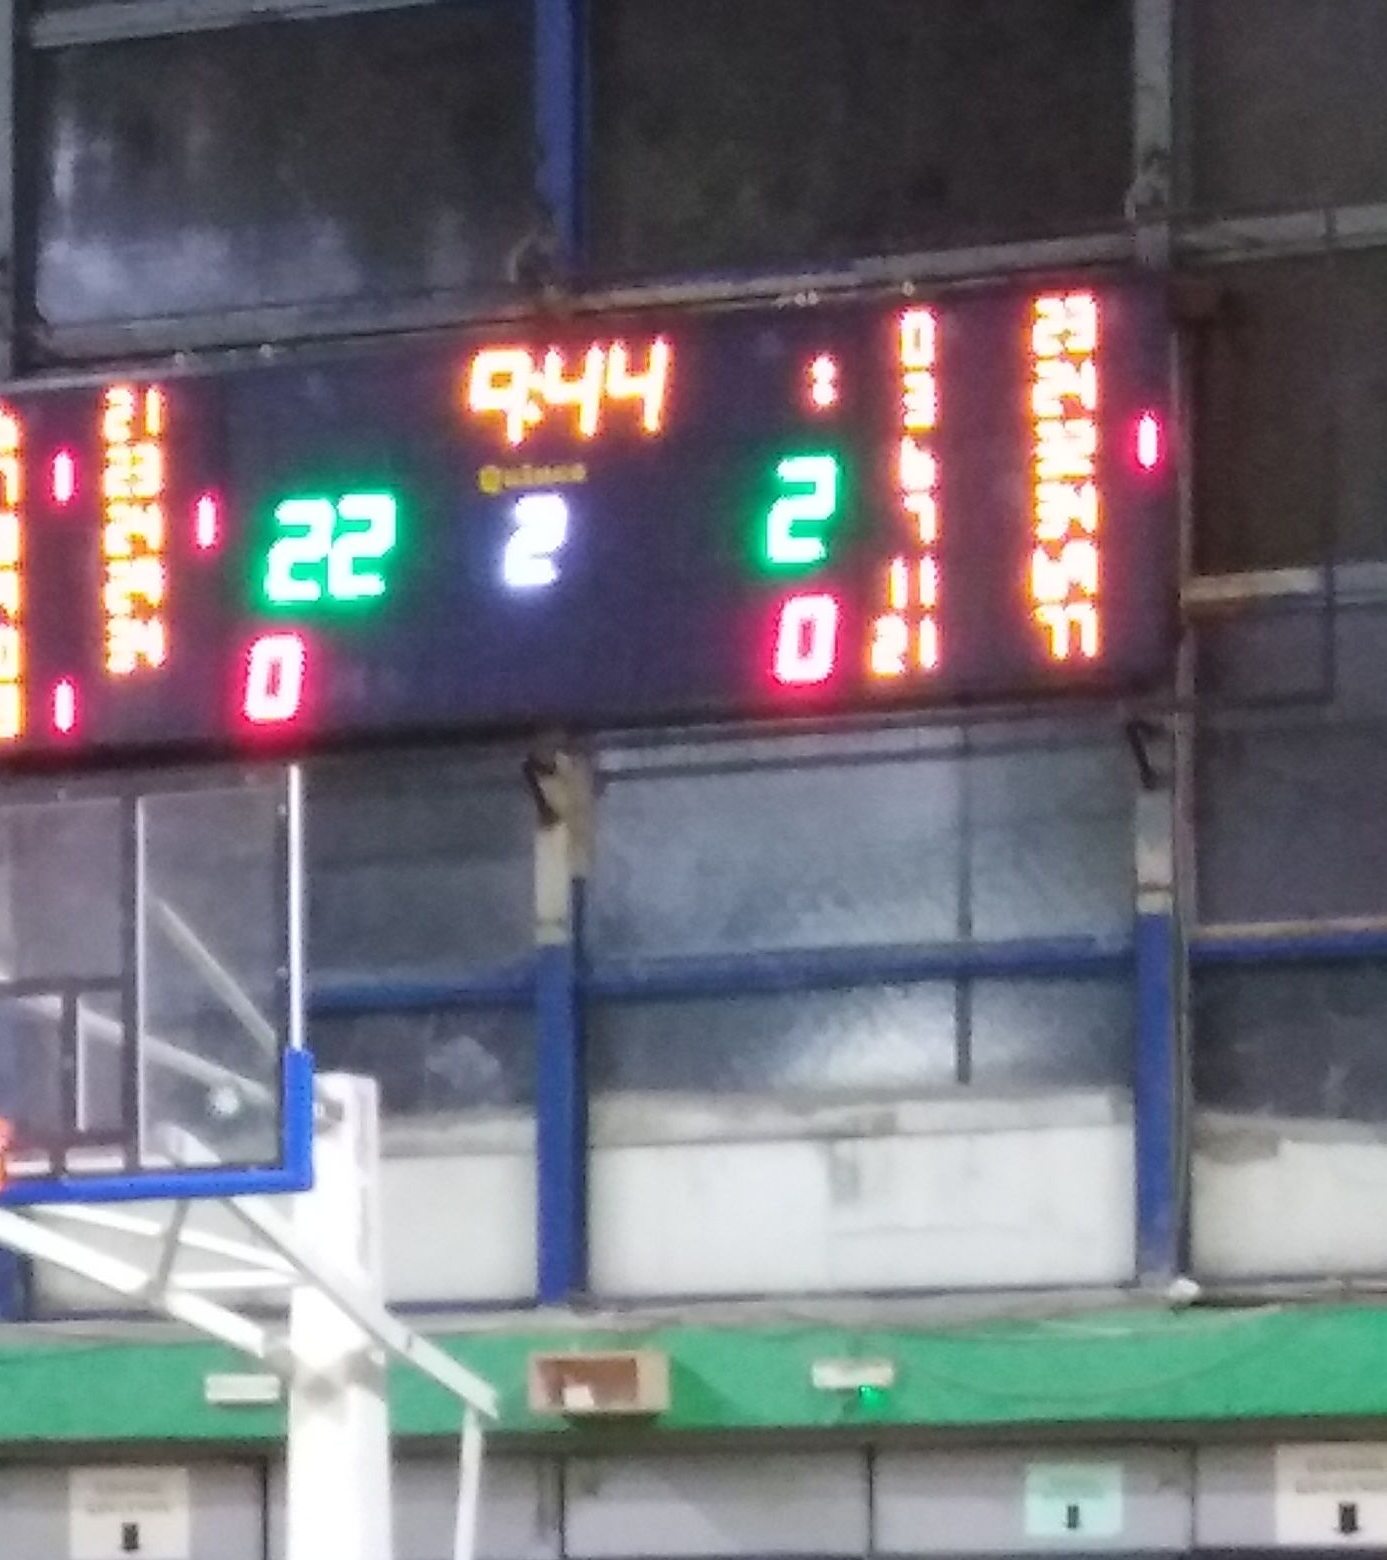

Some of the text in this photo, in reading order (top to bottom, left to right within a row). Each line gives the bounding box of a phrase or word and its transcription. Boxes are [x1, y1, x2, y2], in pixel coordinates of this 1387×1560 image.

[263, 494, 398, 602] 22
[502, 493, 569, 588] 2
[765, 455, 838, 564] 2
[902, 490, 937, 545] 7
[889, 553, 940, 612] 11
[244, 632, 307, 724] 0
[774, 593, 839, 685] 0
